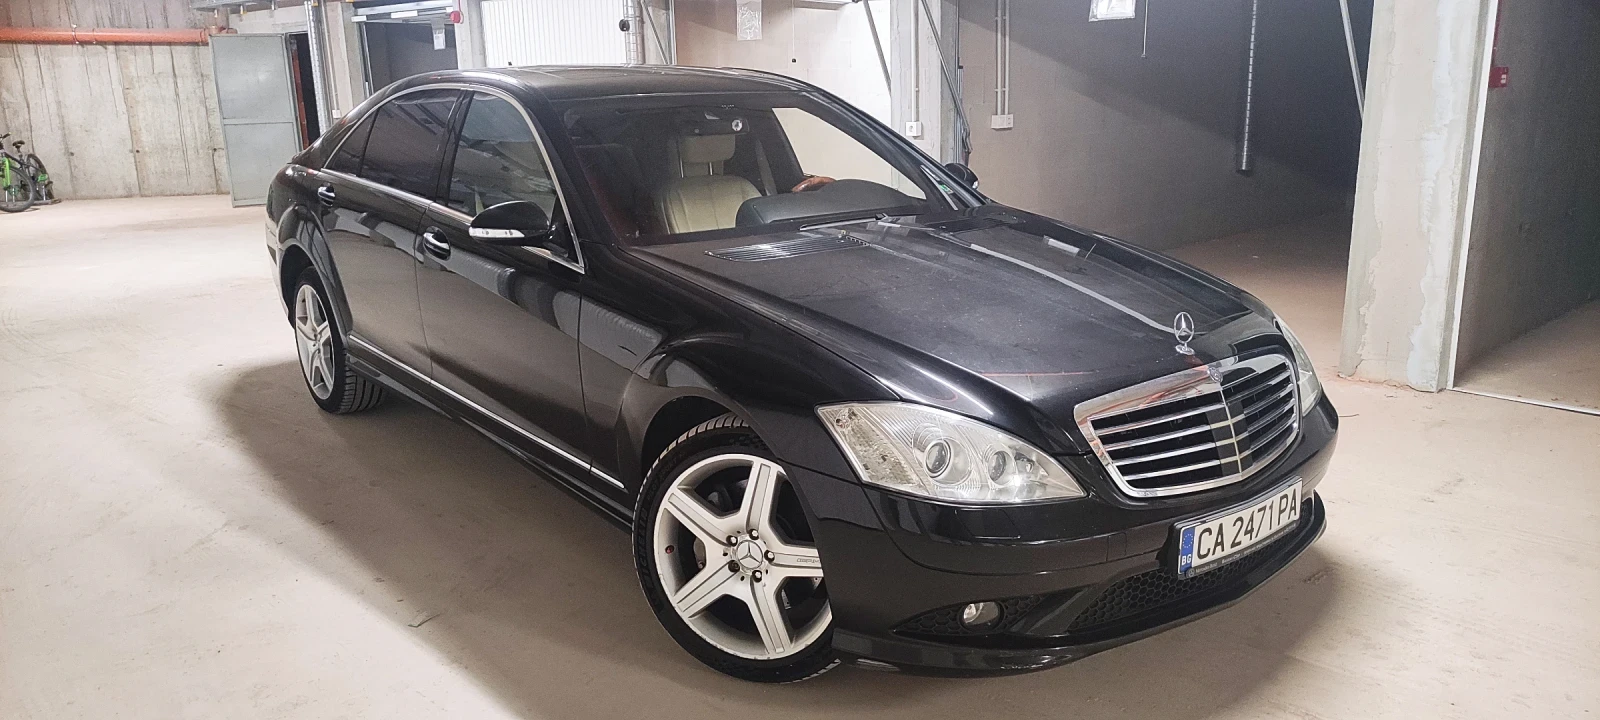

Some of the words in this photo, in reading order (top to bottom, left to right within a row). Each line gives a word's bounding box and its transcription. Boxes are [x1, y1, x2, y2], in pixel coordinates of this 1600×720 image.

[1197, 523, 1225, 560] CA
[1230, 501, 1274, 549] 2471
[1277, 488, 1296, 526] PA
[1181, 553, 1192, 565] BG
